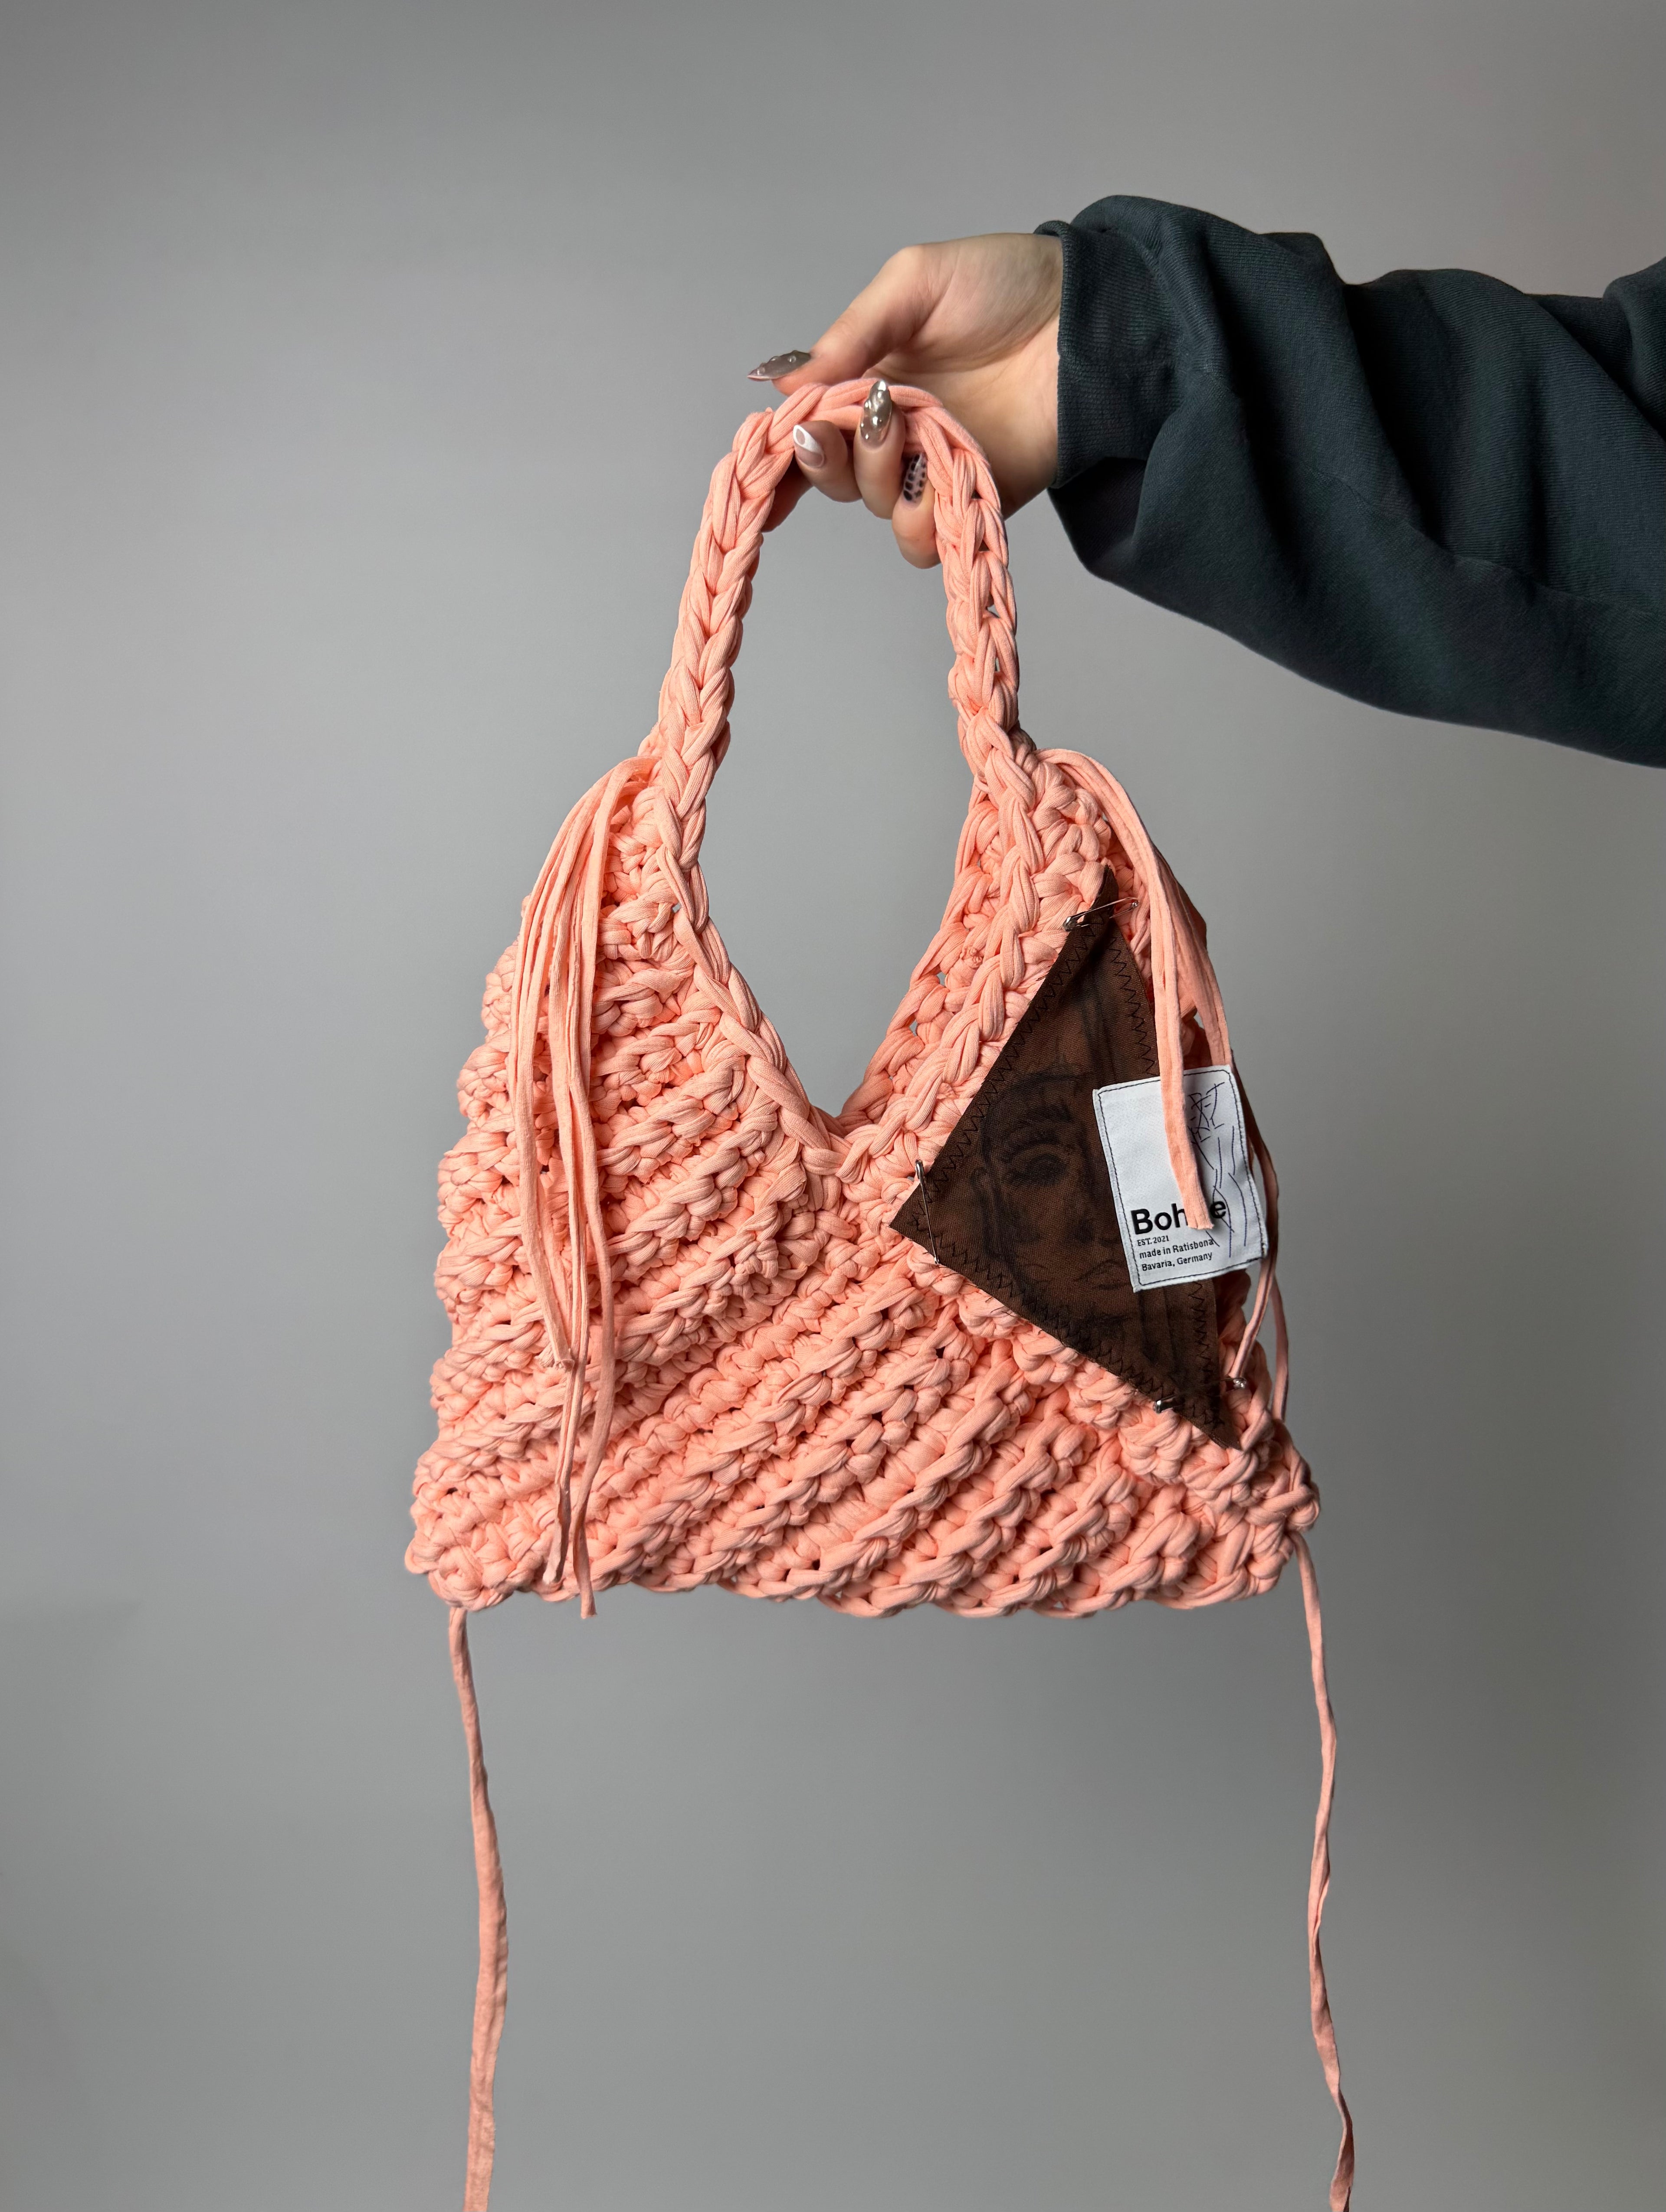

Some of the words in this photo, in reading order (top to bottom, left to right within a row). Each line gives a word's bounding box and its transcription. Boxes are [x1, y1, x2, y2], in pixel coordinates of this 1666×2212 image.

[1131, 1201, 1226, 1234] Bohe
[1139, 1248, 1161, 1259] made
[1172, 1239, 1214, 1253] Ratisbona
[1141, 1260, 1175, 1271] Bavaria,
[1177, 1252, 1213, 1265] Germany
